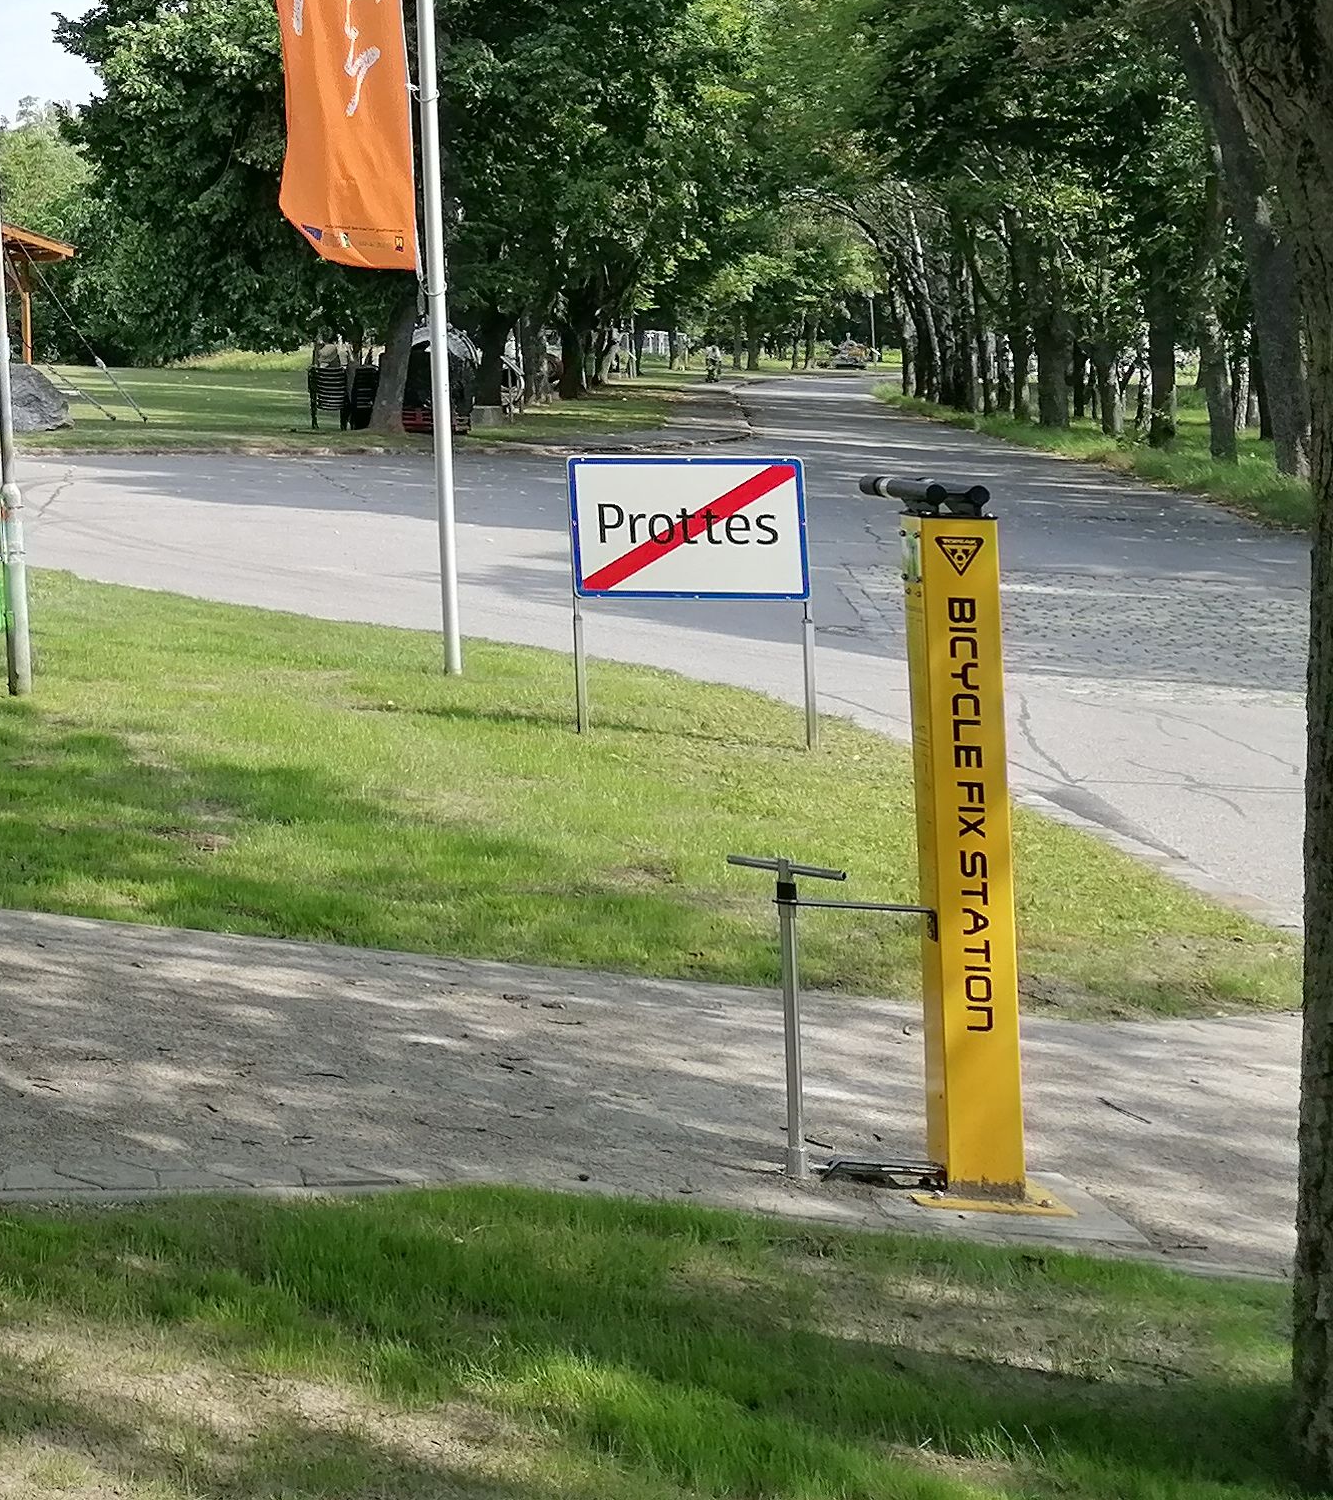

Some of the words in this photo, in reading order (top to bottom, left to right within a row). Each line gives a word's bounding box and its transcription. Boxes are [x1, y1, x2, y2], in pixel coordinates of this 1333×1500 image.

[597, 503, 779, 546] Prottes
[947, 596, 983, 769] BICYCLE
[956, 781, 986, 839] FIX
[958, 851, 994, 1033] STATION
